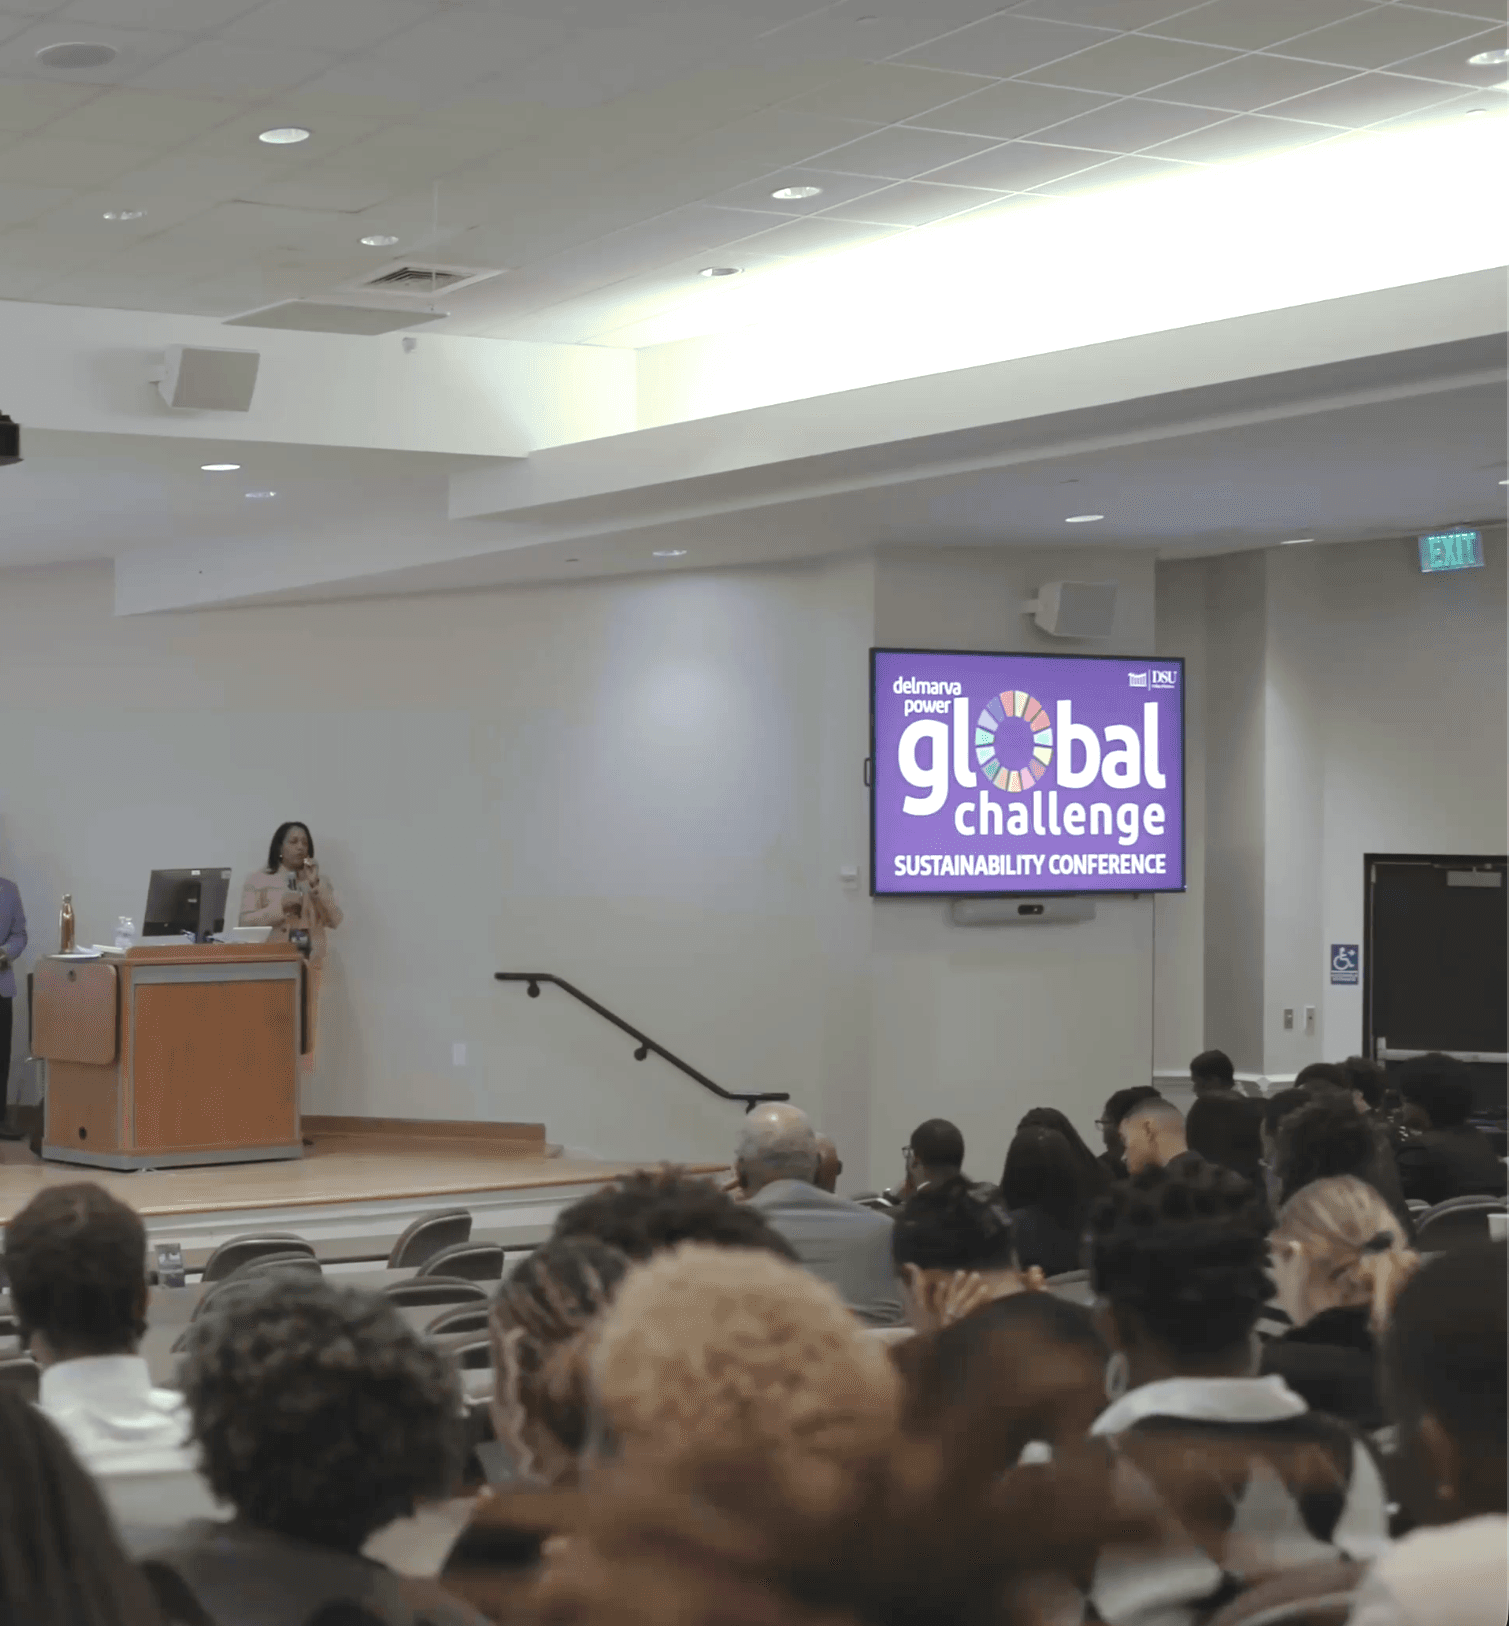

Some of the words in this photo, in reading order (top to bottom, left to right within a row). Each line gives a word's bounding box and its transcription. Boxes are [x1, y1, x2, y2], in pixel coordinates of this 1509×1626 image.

[1428, 532, 1477, 568] EXIT
[892, 676, 962, 696] delmarva
[1152, 670, 1177, 684] DSU
[904, 699, 952, 717] power
[897, 690, 1167, 816] global
[954, 790, 1166, 846] challenge
[893, 853, 1046, 877] SUSTAINABILITY
[1048, 853, 1167, 876] CONFERENCE
